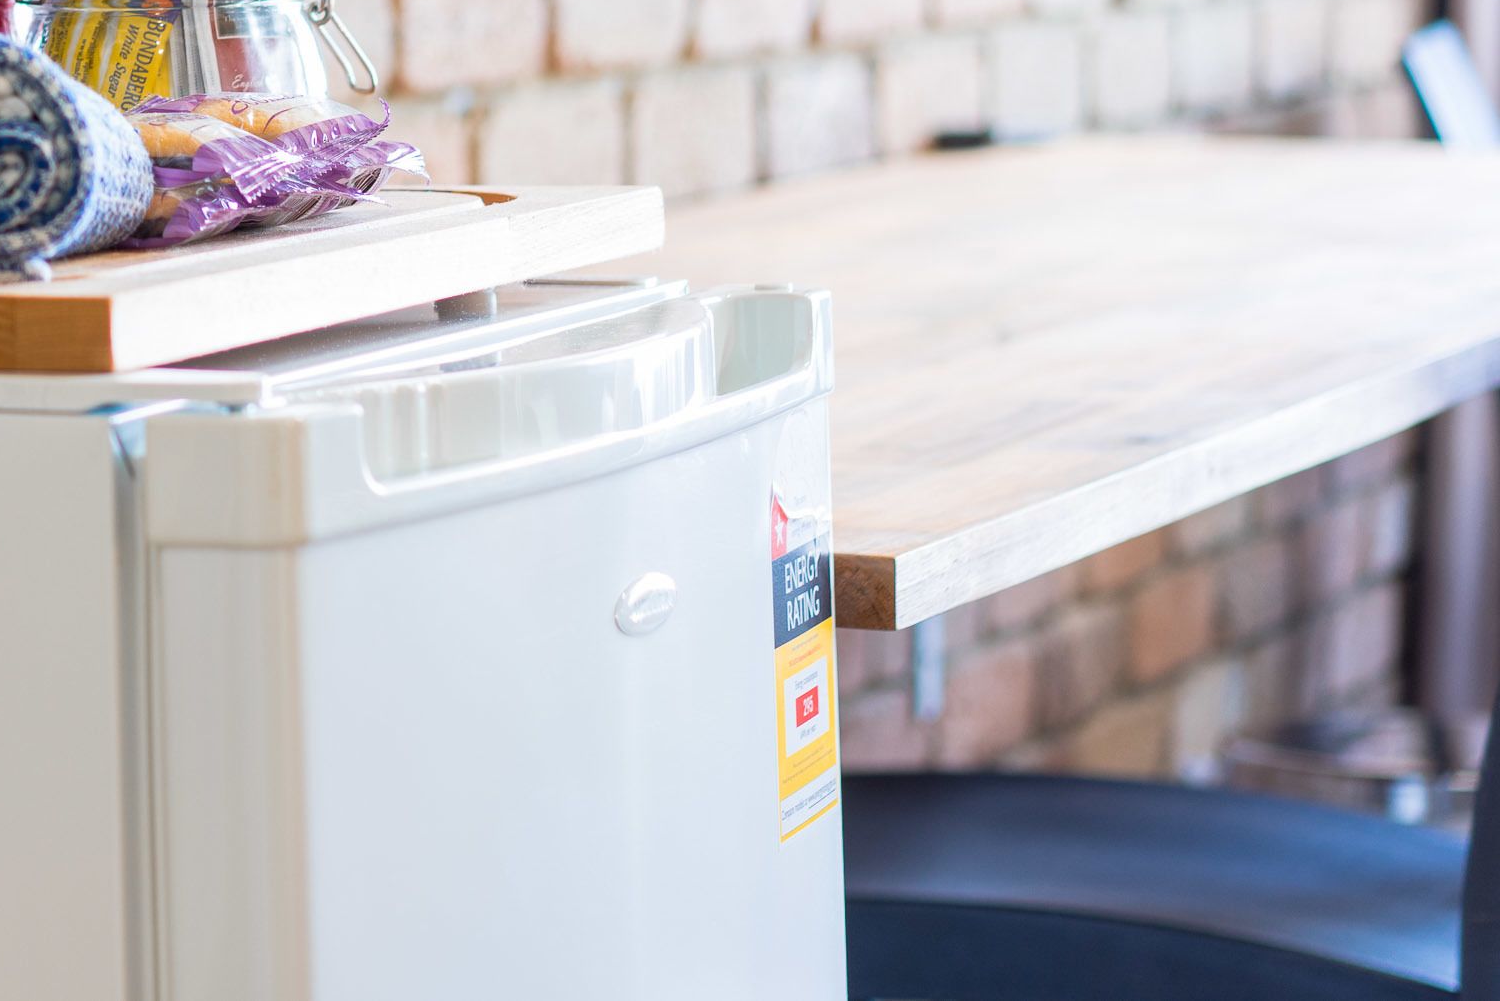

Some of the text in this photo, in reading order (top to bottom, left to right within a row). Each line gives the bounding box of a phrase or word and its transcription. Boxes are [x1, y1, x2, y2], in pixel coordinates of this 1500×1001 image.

[107, 24, 140, 99] White Sugar
[784, 547, 821, 594] ENERGY
[786, 585, 820, 631] RATING
